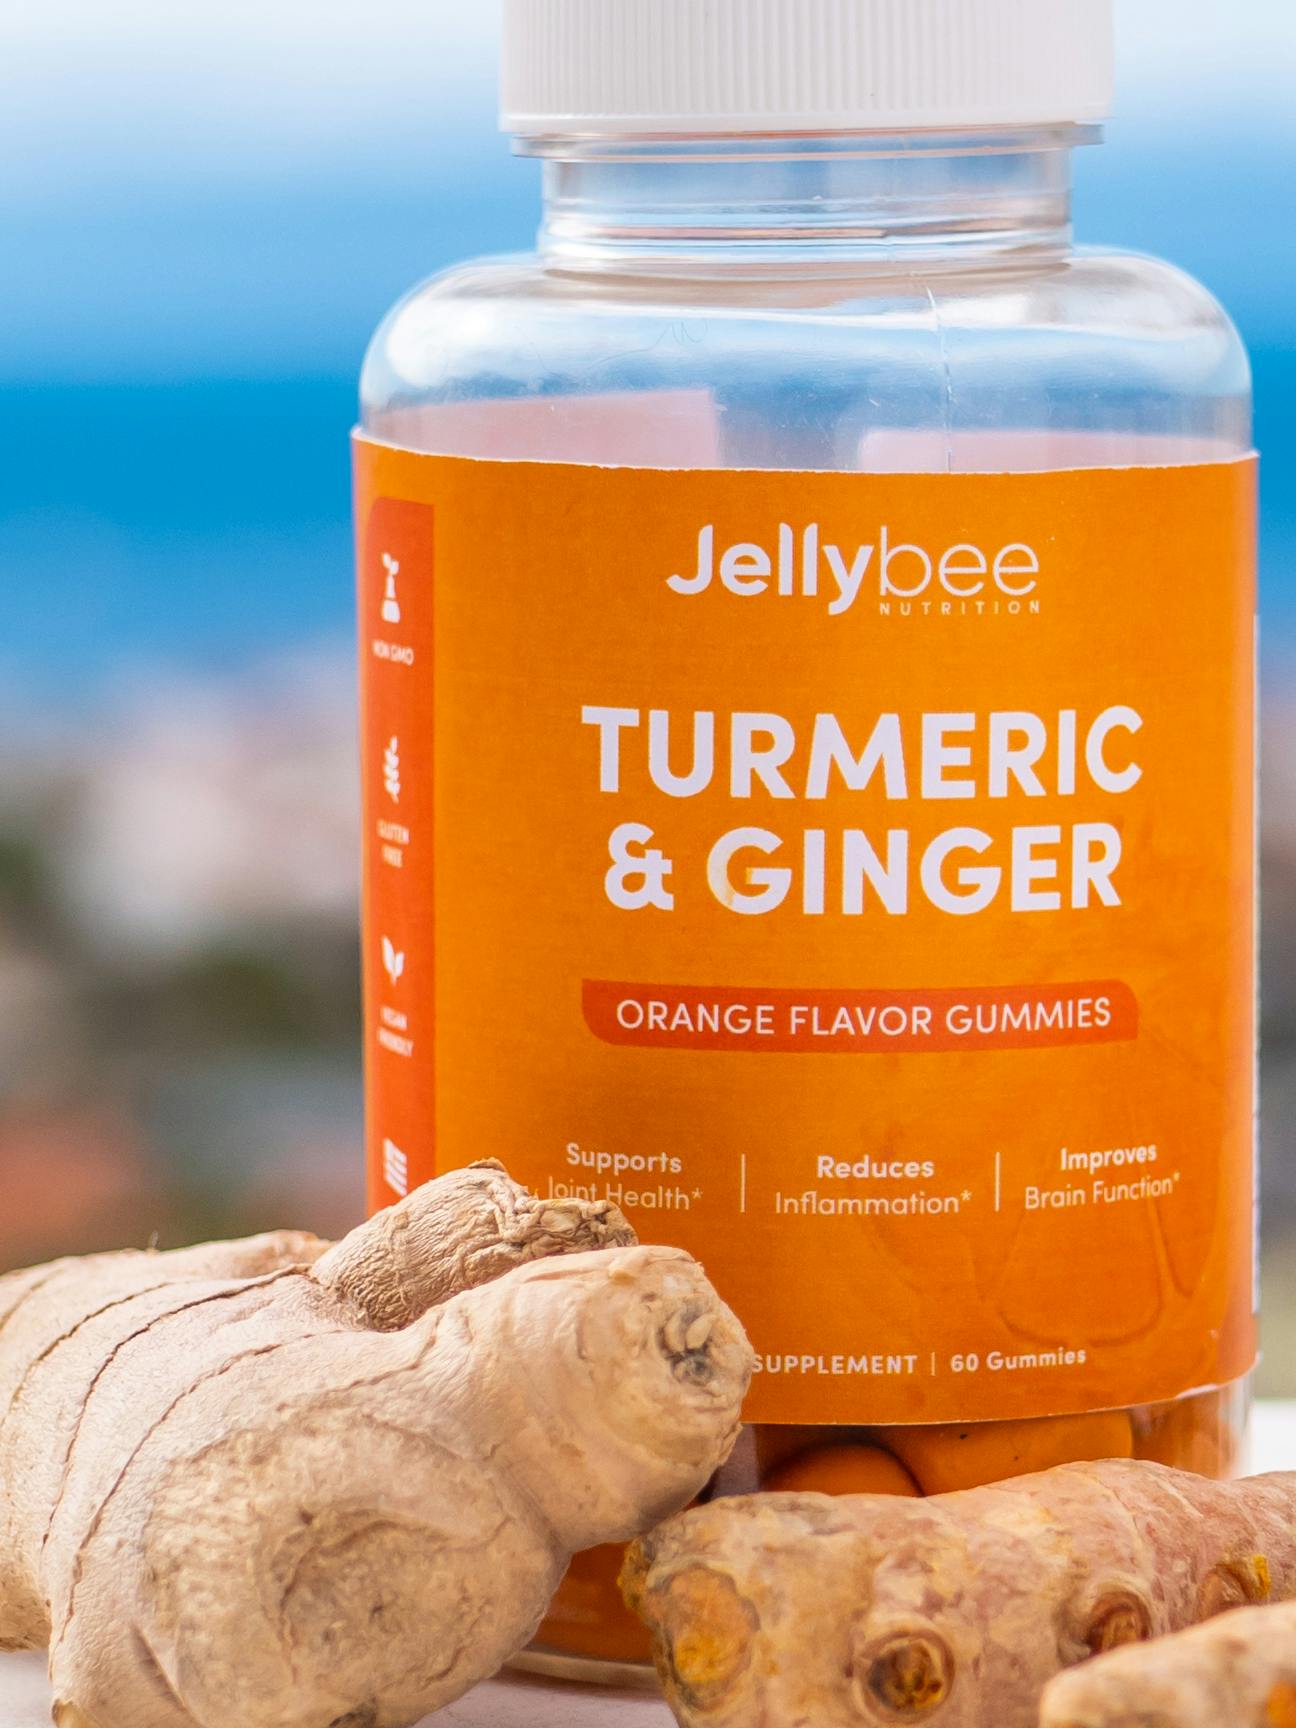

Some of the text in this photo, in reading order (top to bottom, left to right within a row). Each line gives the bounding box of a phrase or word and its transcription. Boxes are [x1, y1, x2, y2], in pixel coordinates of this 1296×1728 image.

[665, 521, 1040, 617] Jellybee
[879, 600, 1041, 616] NUTRITION
[581, 704, 1144, 800] TURMERIC
[603, 821, 1123, 916] & GINGER
[615, 996, 1111, 1038] ORANGE FLAVOR GUMMIES
[565, 1141, 683, 1176] Supports
[816, 1154, 935, 1180] Reduces
[1059, 1144, 1158, 1175] Improves
[1024, 1184, 1086, 1211] Brain
[751, 1346, 1088, 1375] SUPPLEMENT 60 Gummies
